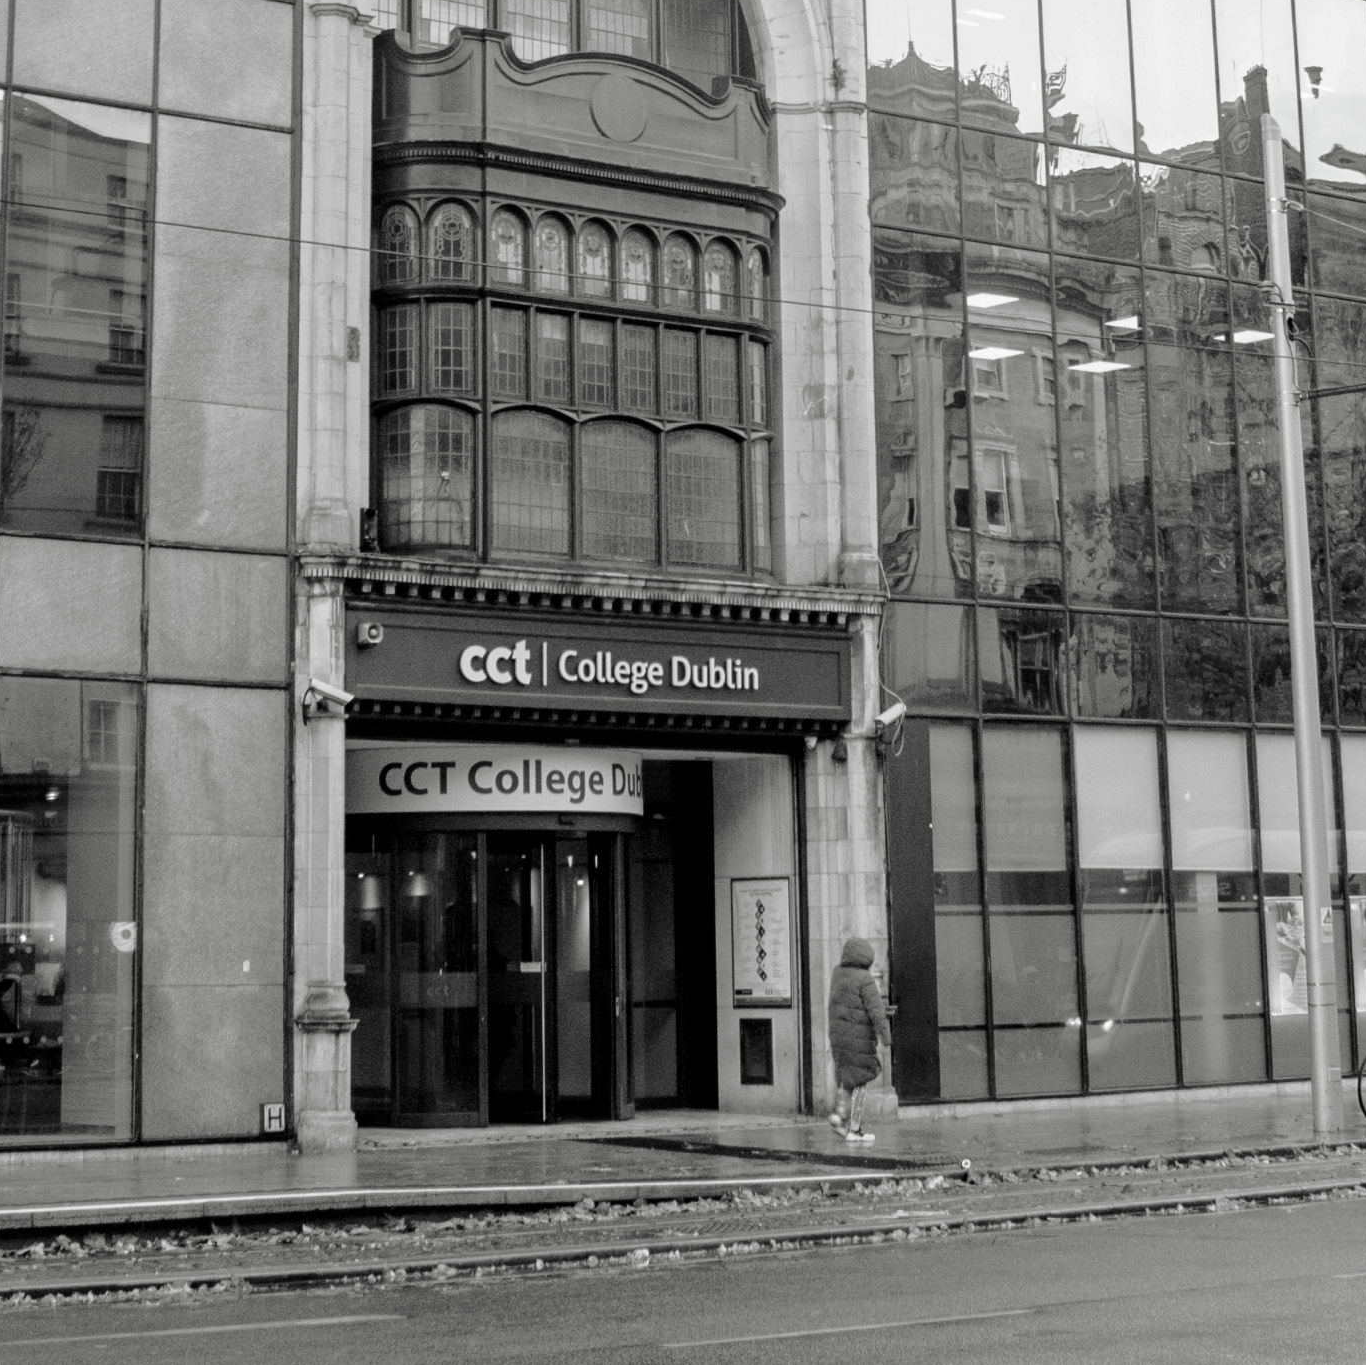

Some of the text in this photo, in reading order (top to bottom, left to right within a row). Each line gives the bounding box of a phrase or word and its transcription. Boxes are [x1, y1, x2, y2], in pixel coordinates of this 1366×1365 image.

[459, 639, 759, 694] cct College Dublin
[378, 761, 456, 797] CCT
[467, 759, 605, 805] College
[268, 1107, 282, 1129] H
